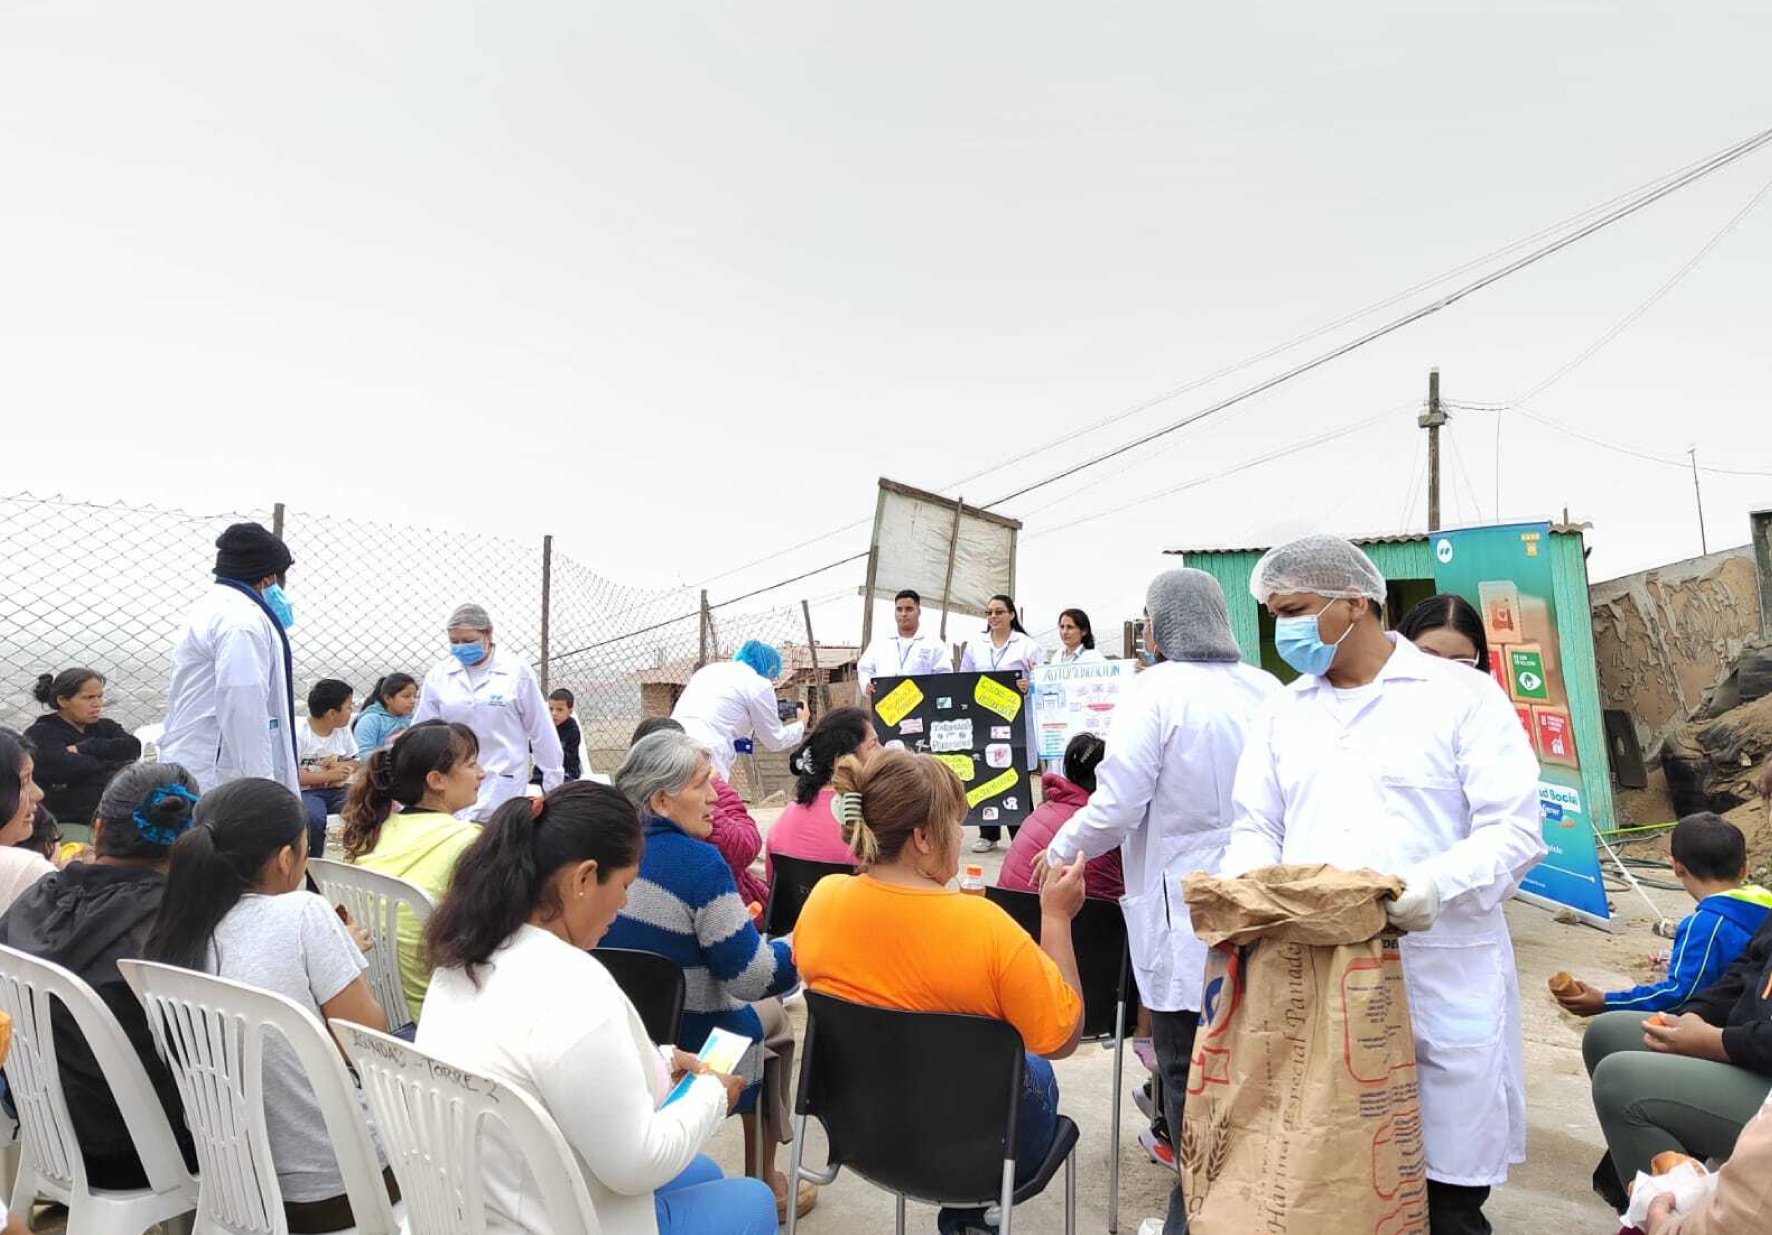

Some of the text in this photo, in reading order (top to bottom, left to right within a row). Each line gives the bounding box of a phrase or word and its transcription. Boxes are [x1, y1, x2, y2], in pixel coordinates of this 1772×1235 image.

[424, 1057, 480, 1093] TORRE
[1264, 1140, 1289, 1234] Harina
[1282, 1032, 1307, 1132] Especial
